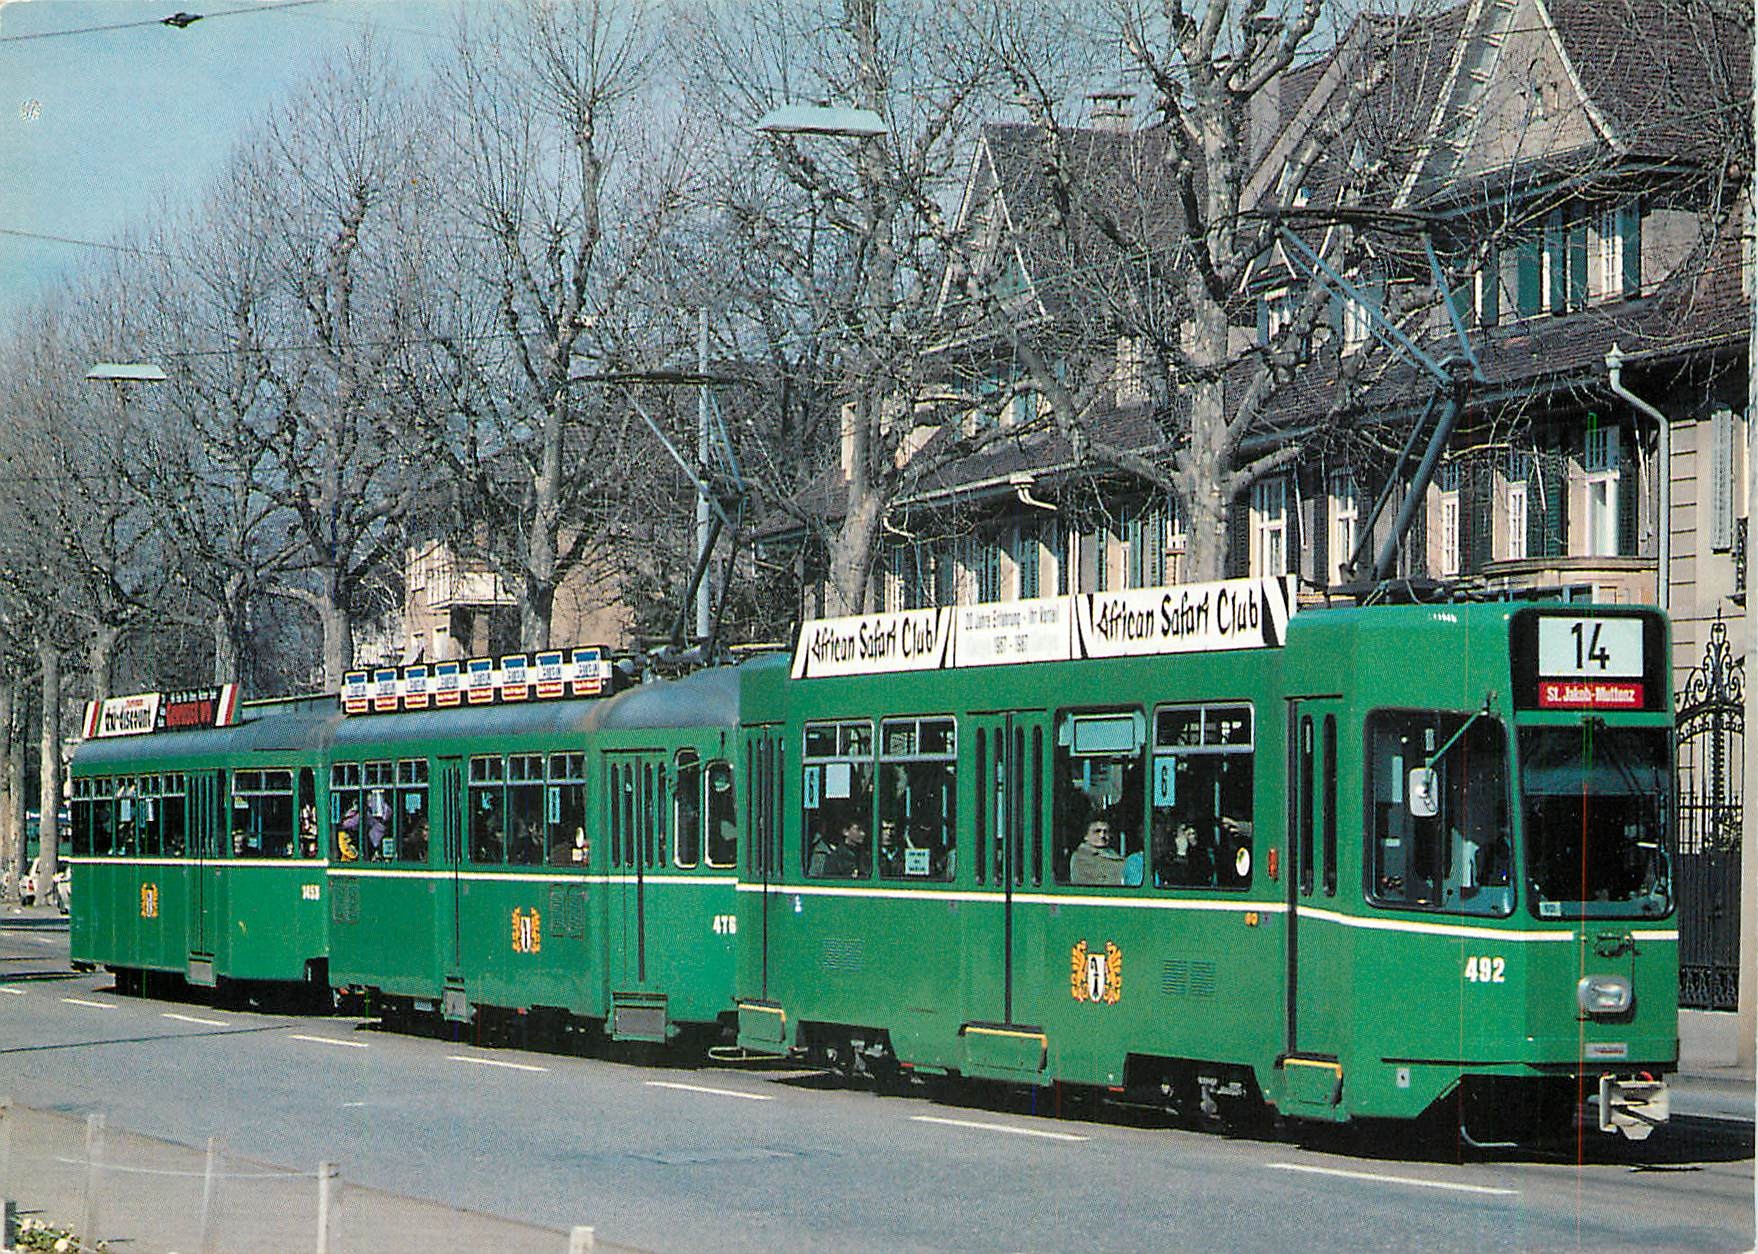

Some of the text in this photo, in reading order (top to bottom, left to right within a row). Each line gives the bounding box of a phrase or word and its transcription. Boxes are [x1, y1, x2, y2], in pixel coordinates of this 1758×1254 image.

[1096, 587, 1259, 643] African Safari Club
[811, 627, 855, 662] African
[859, 619, 898, 661] Safari
[902, 617, 934, 659] Club
[1571, 622, 1610, 670] 14
[1464, 956, 1505, 983] 492
